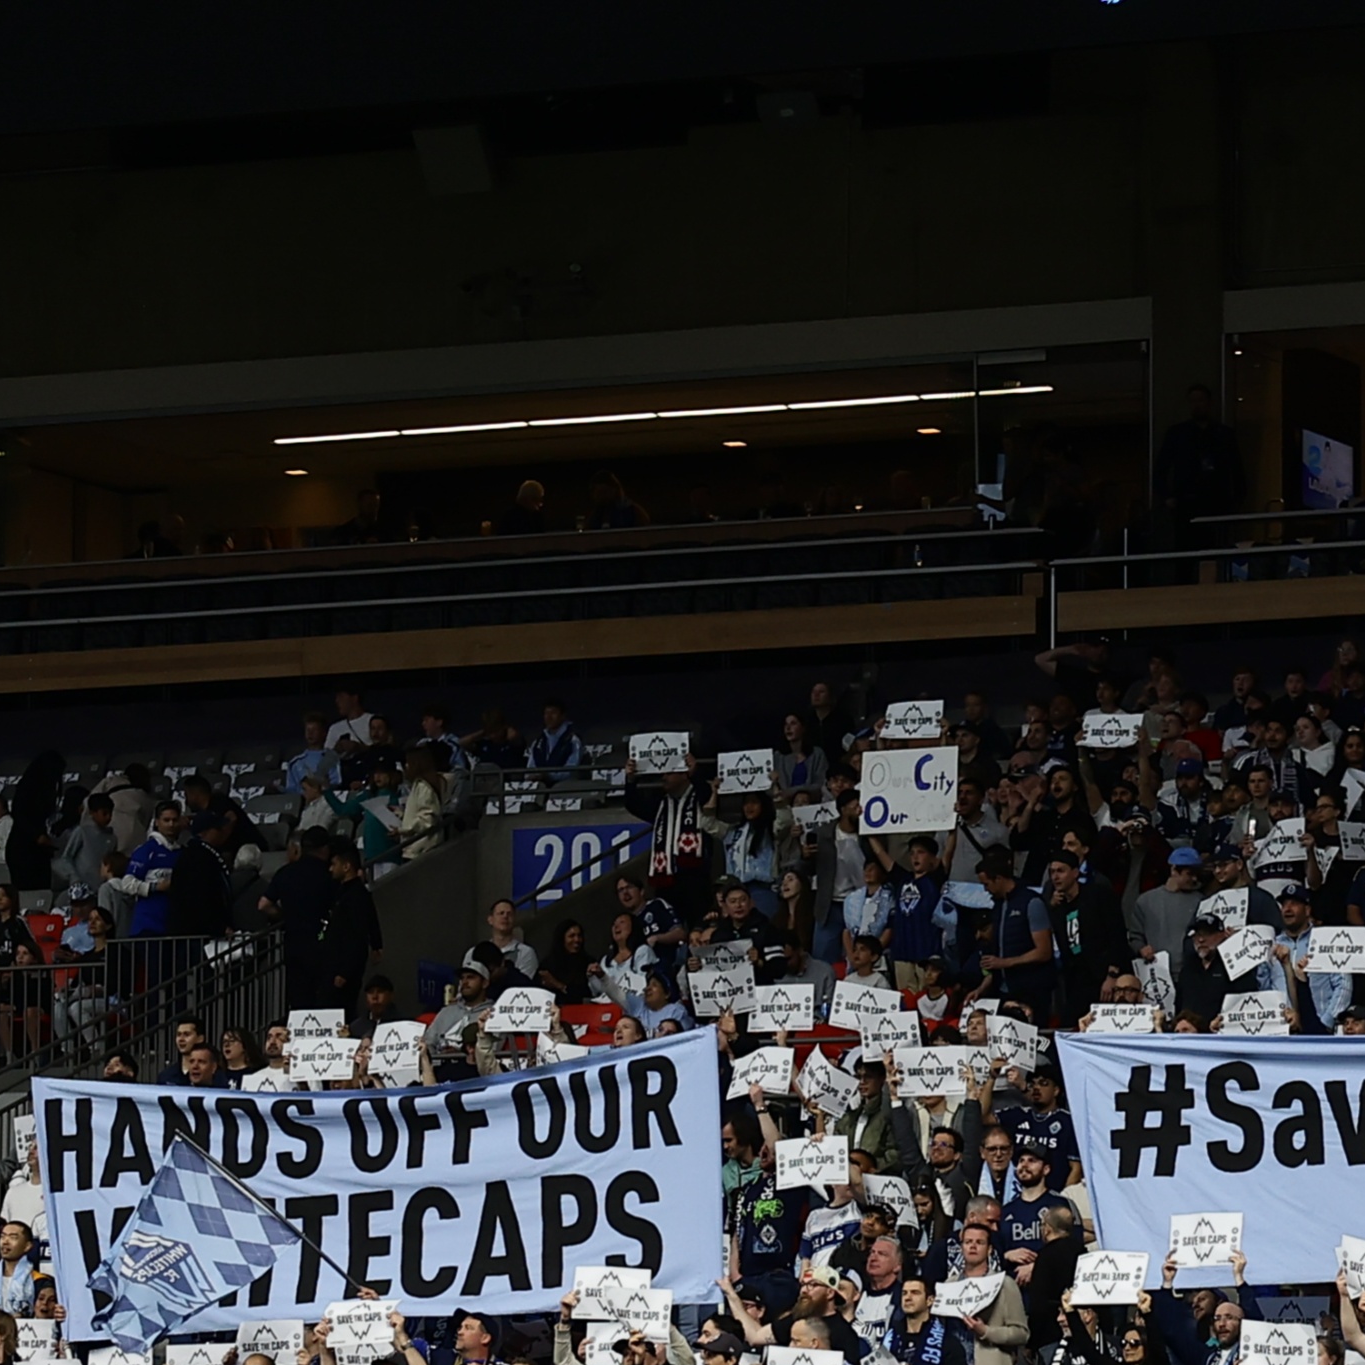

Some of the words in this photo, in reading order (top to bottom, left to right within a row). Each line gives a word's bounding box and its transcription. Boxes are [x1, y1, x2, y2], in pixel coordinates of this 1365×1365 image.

[915, 753, 954, 794] City
[864, 796, 908, 828] Our
[535, 829, 631, 901] 201
[44, 1095, 324, 1193] HANDS
[343, 1086, 489, 1174] OFF
[511, 1056, 682, 1159] OUR
[1015, 1133, 1058, 1148] TELUS
[75, 1170, 663, 1316] TECAPS
[1012, 1220, 1040, 1241] Bell
